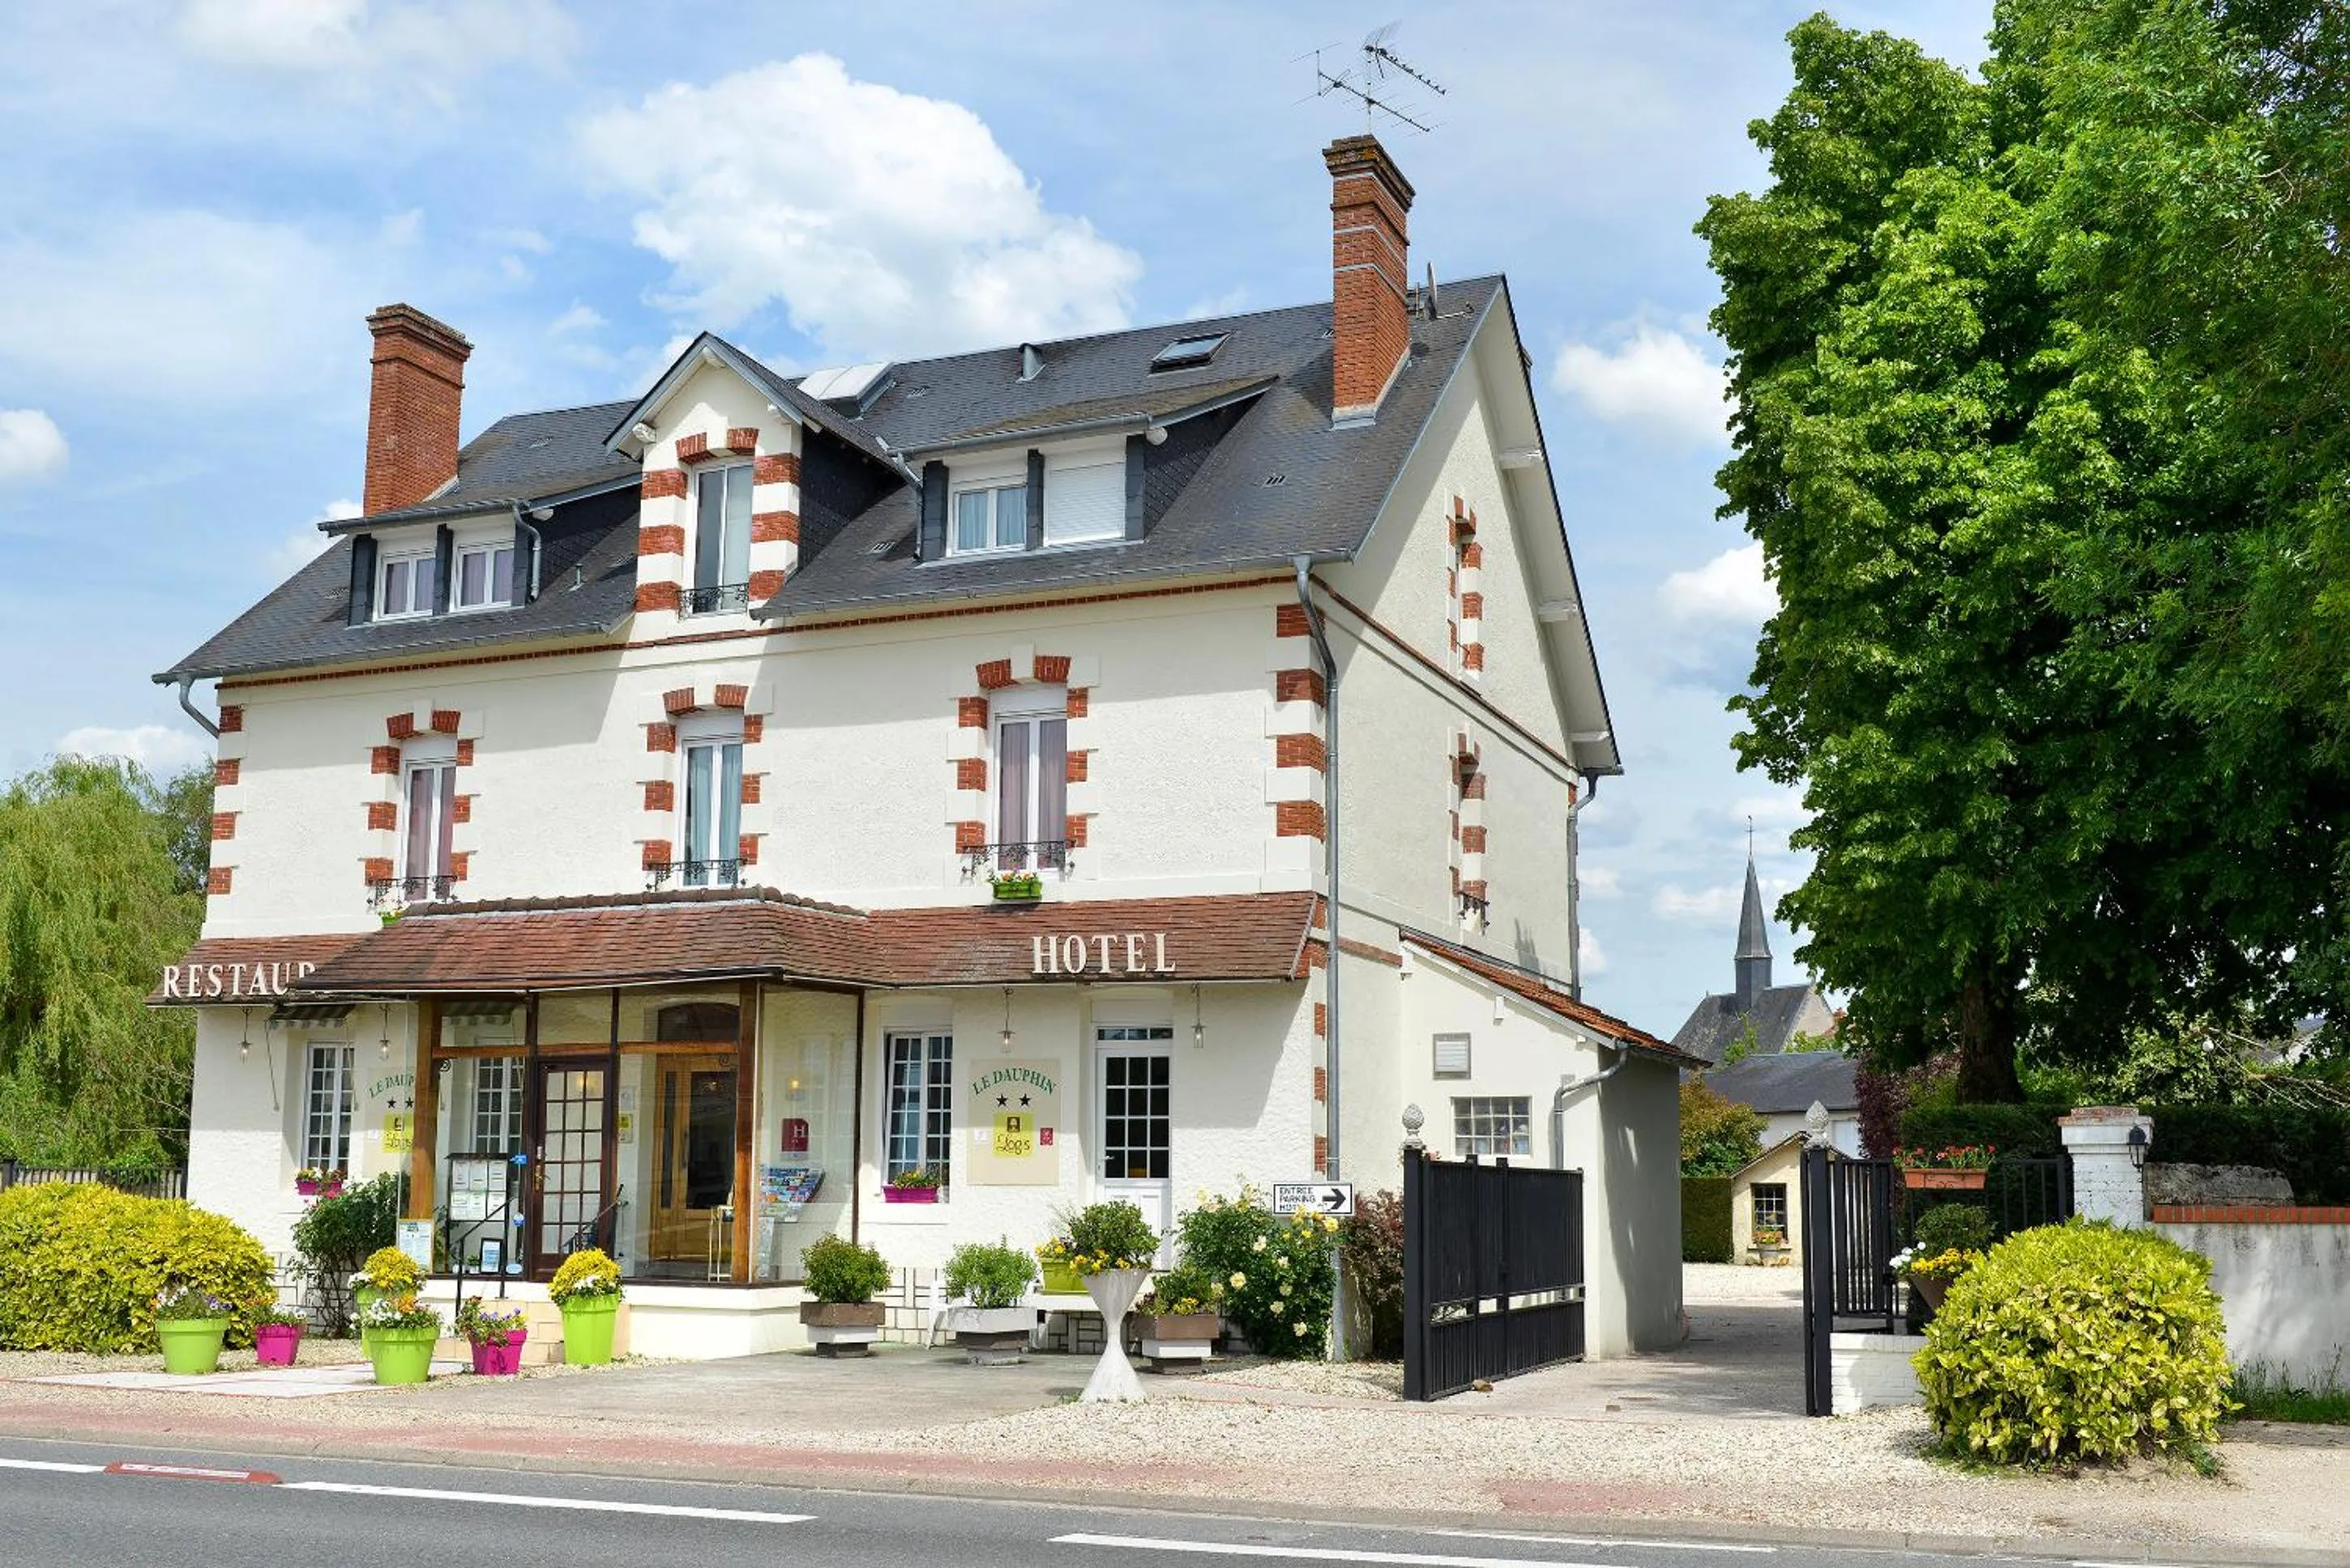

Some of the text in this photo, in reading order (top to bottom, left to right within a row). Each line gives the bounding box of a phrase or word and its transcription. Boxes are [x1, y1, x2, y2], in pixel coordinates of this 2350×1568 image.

[1032, 933, 1176, 974] HOTEL
[370, 1074, 414, 1098] LE DAUP
[972, 1067, 1056, 1096] LE DAUPHIN
[1280, 1186, 1314, 1194] ENTREE
[1280, 1194, 1316, 1203] PARKING
